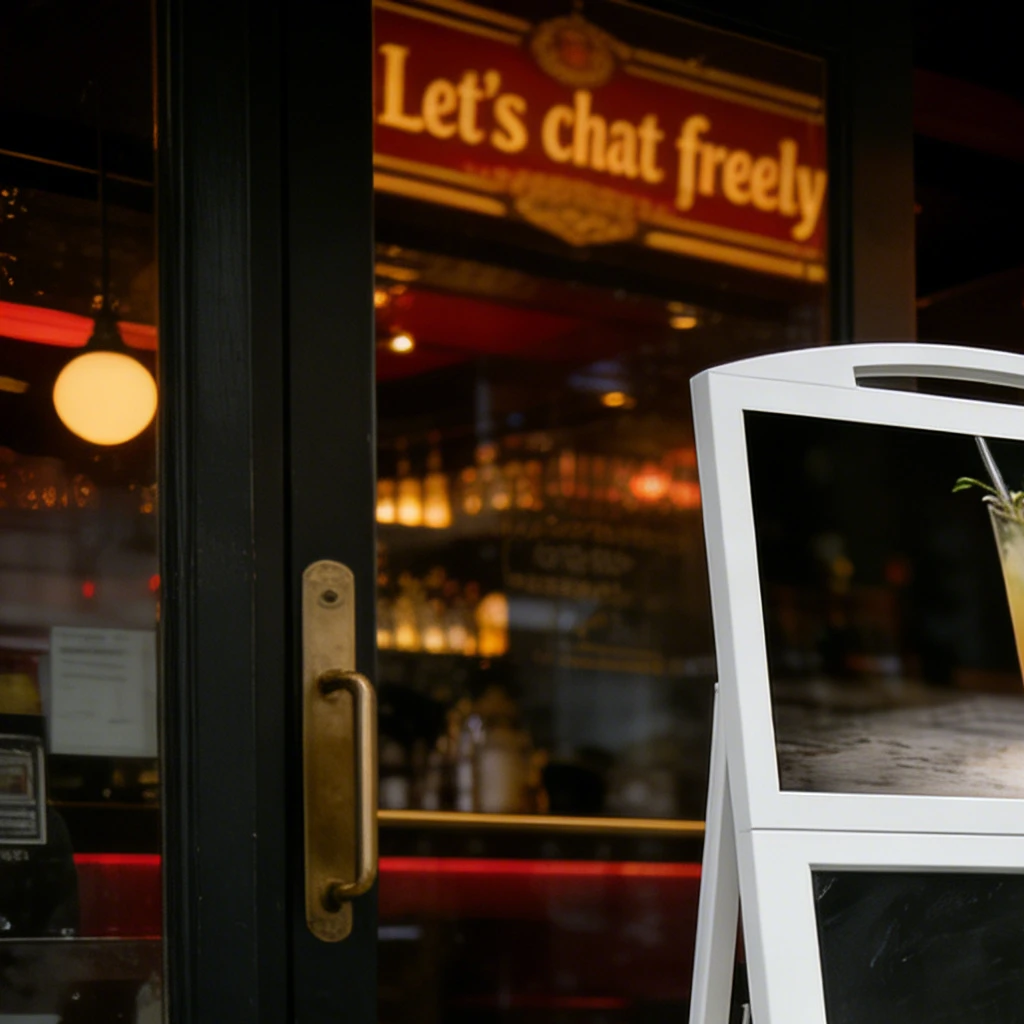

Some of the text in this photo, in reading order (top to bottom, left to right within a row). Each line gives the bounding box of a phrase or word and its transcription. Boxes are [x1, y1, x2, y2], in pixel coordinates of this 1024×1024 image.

[378, 43, 828, 241] Let's chat freely
